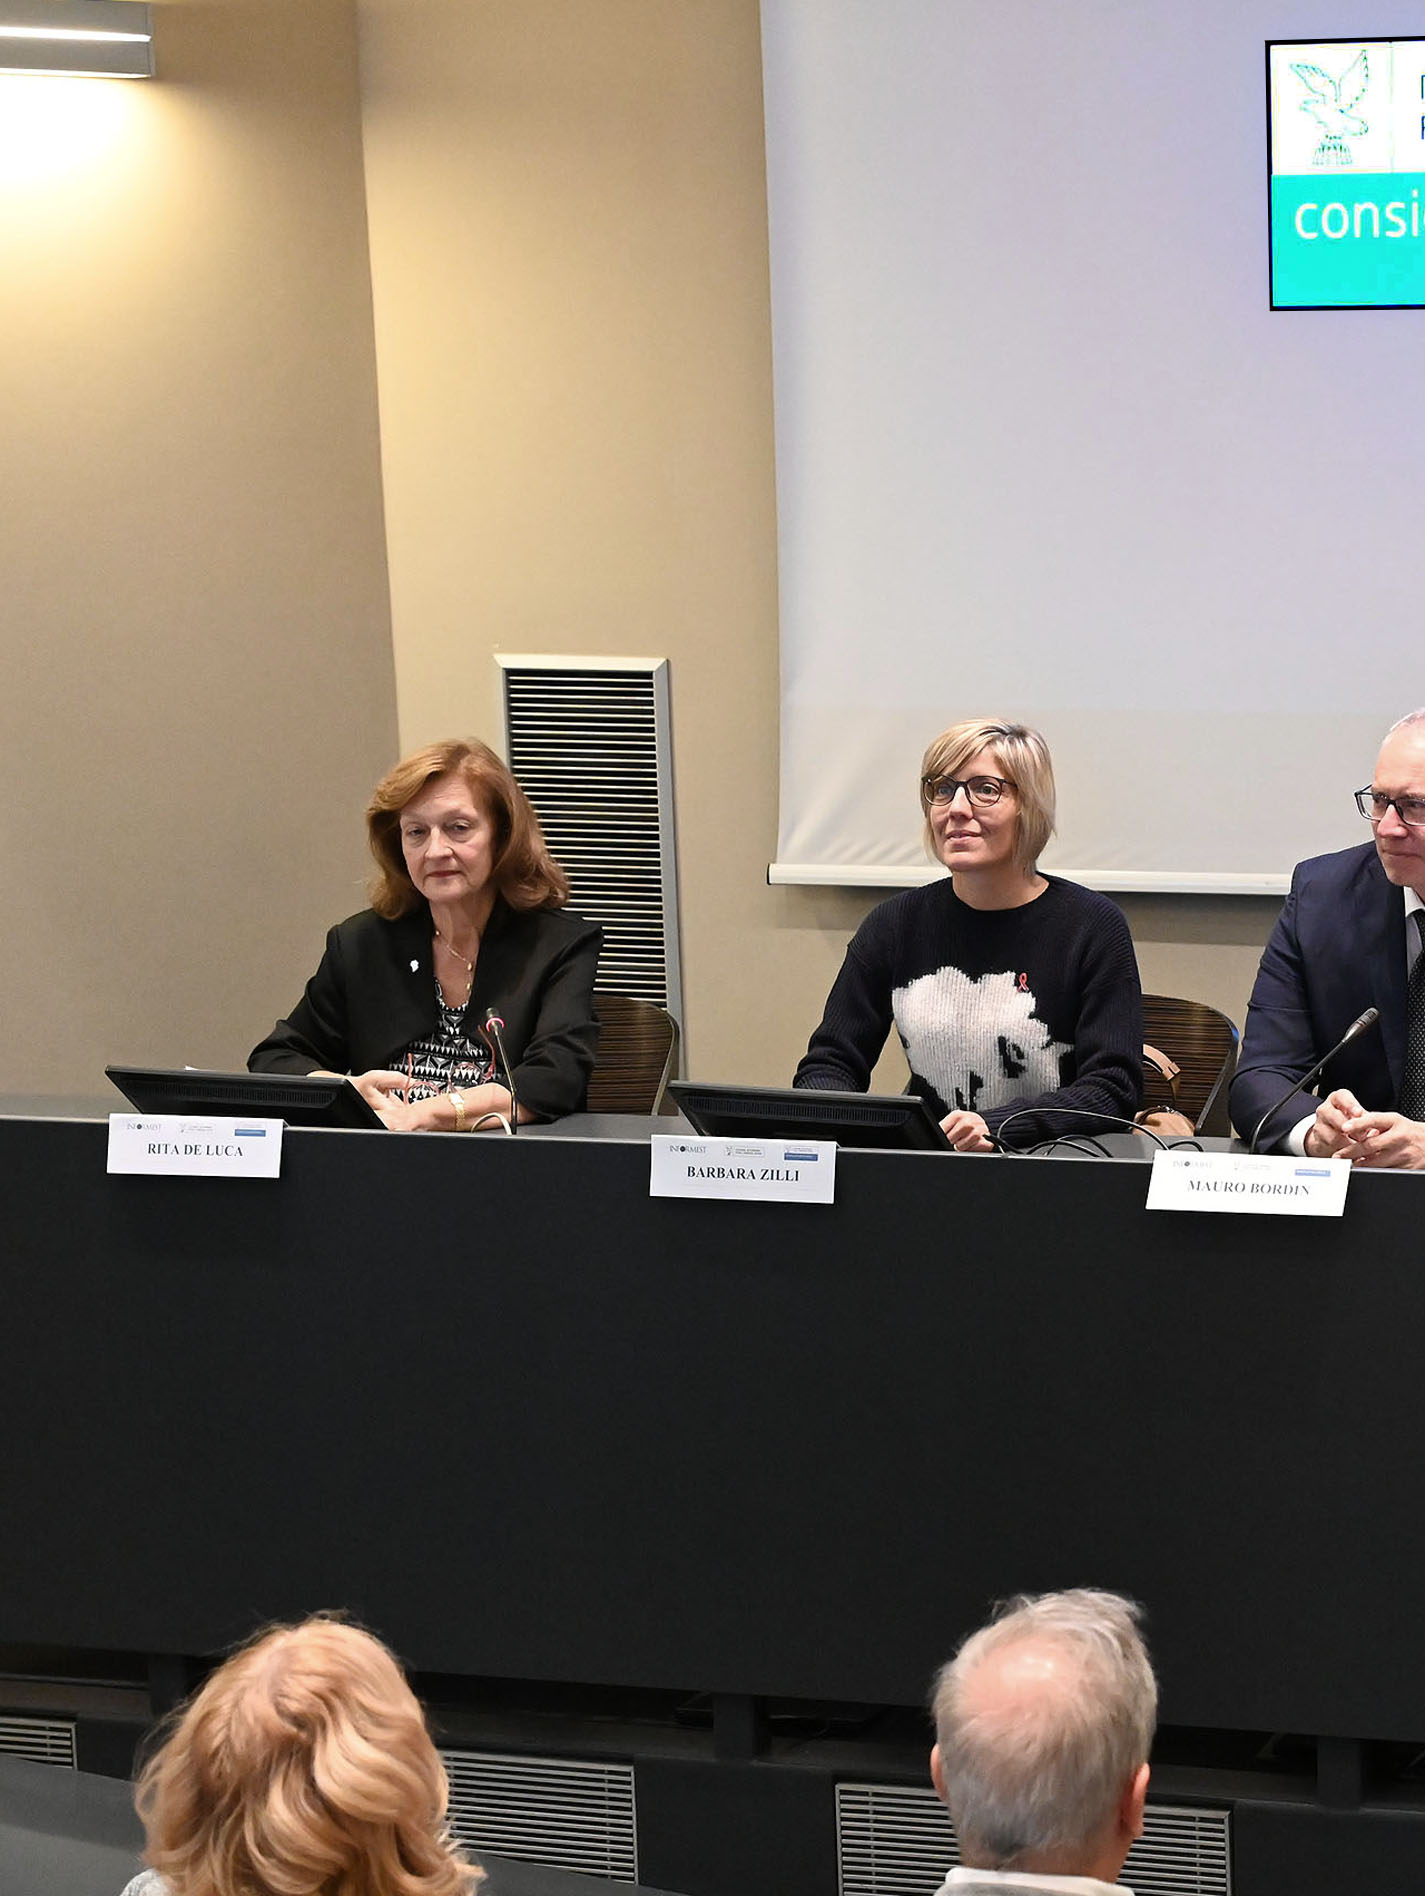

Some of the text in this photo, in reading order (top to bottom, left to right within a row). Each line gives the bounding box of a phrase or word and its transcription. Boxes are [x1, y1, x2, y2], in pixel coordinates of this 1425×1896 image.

[148, 1143, 243, 1157] RITA DE LUCA
[687, 1166, 799, 1182] BARBARA ZILLI
[1188, 1179, 1311, 1195] MAURO BORDIN
